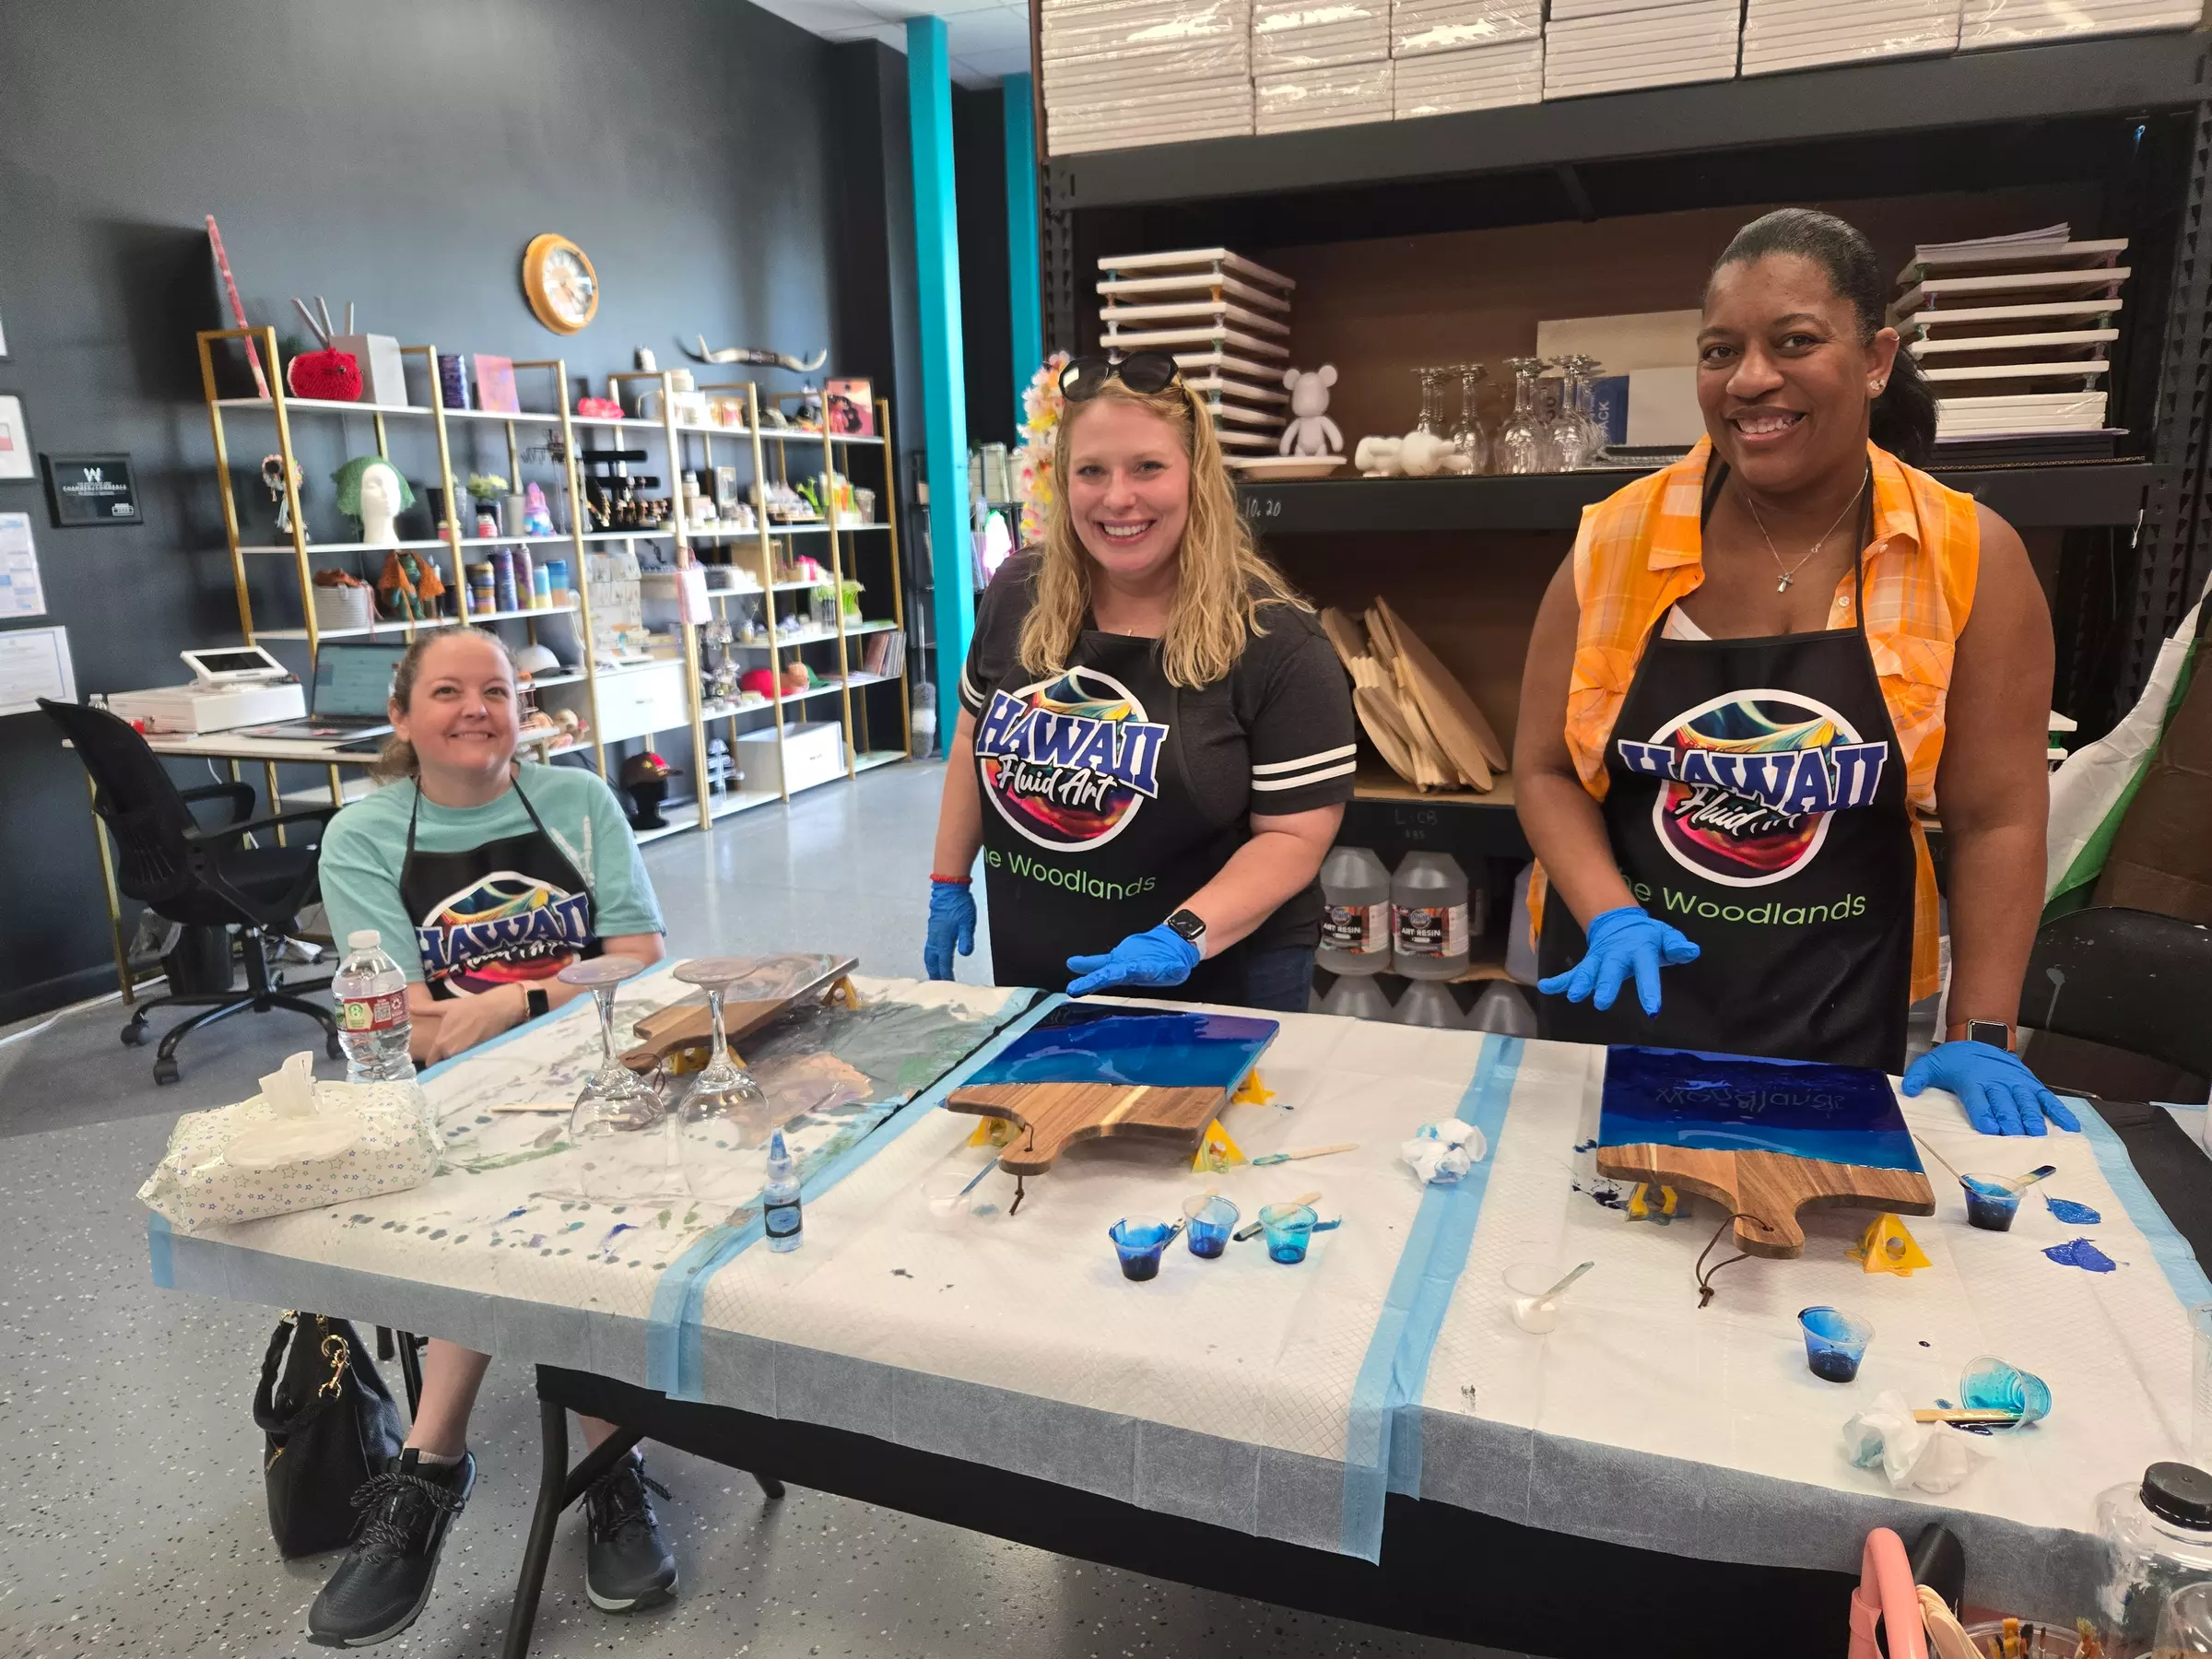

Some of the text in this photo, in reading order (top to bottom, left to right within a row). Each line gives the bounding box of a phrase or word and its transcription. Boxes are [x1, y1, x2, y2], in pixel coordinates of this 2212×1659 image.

[975, 689, 1170, 799] HAWAII
[996, 754, 1117, 811] Fluid Art
[1675, 783, 1767, 836] Fluid
[1007, 851, 1157, 900] Woodlands
[1323, 923, 1361, 934] ART RESIN
[1662, 887, 1867, 925] Woodlands
[416, 891, 597, 979] HAWAII
[1401, 927, 1441, 937] ART RESIN
